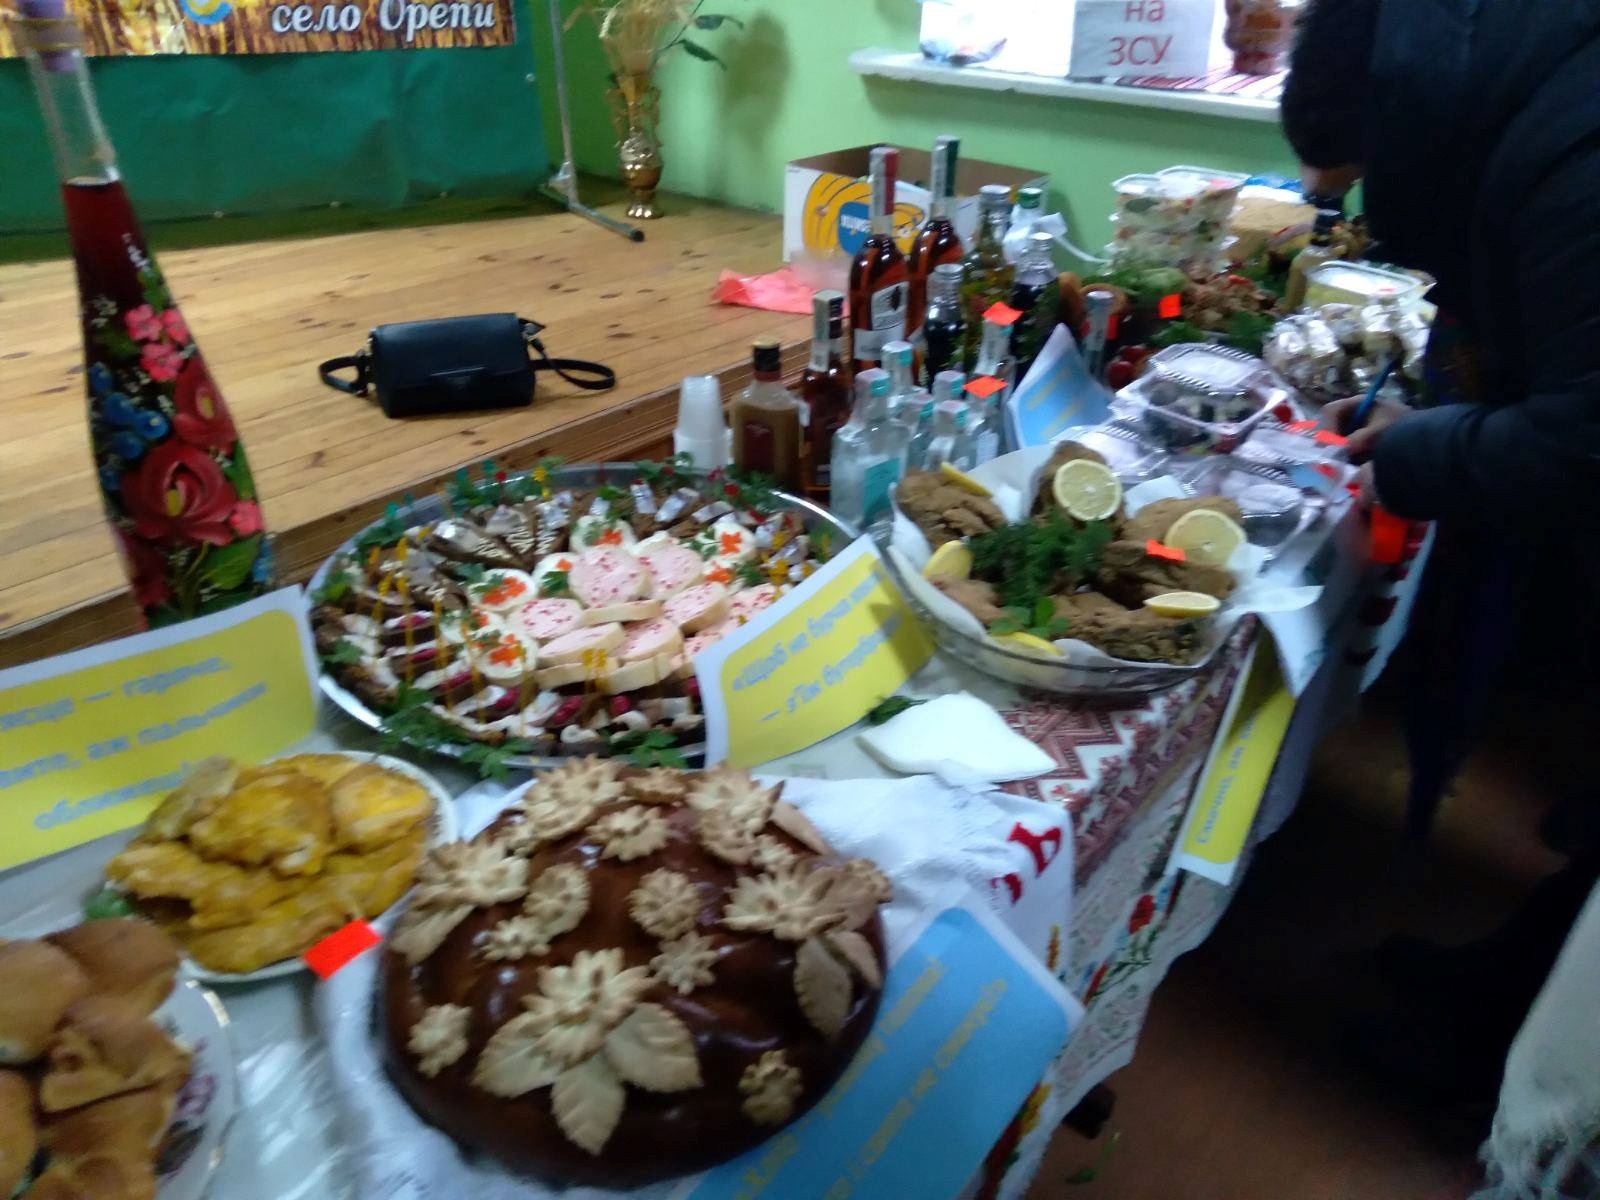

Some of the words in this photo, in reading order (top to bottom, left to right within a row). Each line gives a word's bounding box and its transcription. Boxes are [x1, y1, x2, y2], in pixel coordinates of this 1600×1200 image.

[271, 4, 362, 33] село
[379, 0, 496, 42] Орепи
[1106, 34, 1174, 66] ЗСУ
